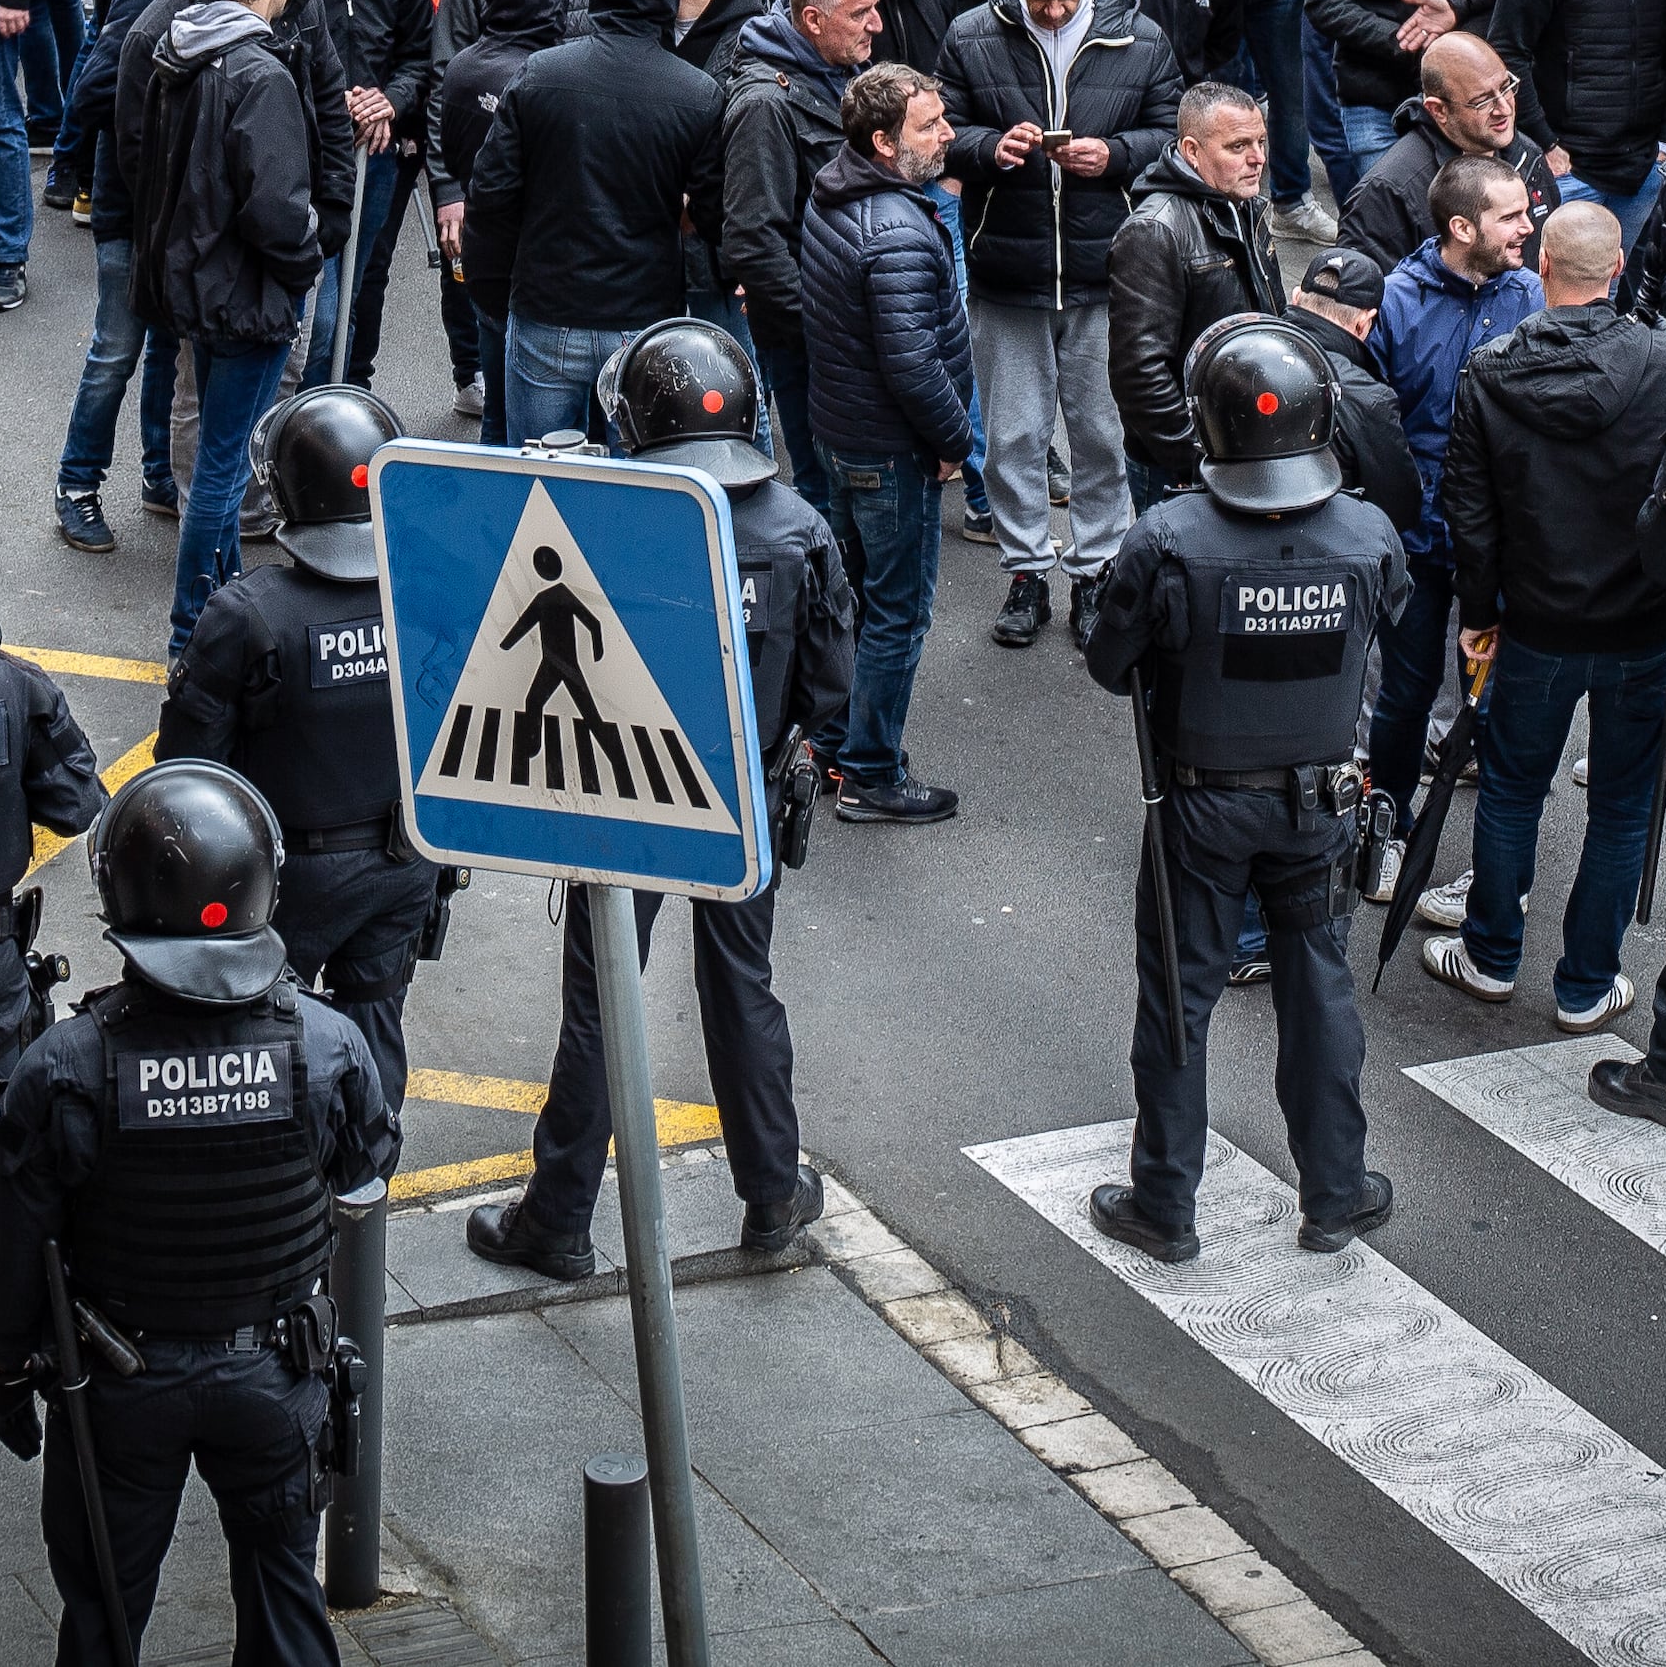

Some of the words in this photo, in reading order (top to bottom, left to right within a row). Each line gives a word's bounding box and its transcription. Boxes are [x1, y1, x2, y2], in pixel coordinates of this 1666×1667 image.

[1237, 583, 1347, 613] POLICIA
[1244, 612, 1342, 632] D311A9717
[319, 624, 386, 661] POLI
[332, 657, 388, 680] D304A
[138, 1050, 278, 1092] POLICIA
[147, 1089, 271, 1118] D313B7198
